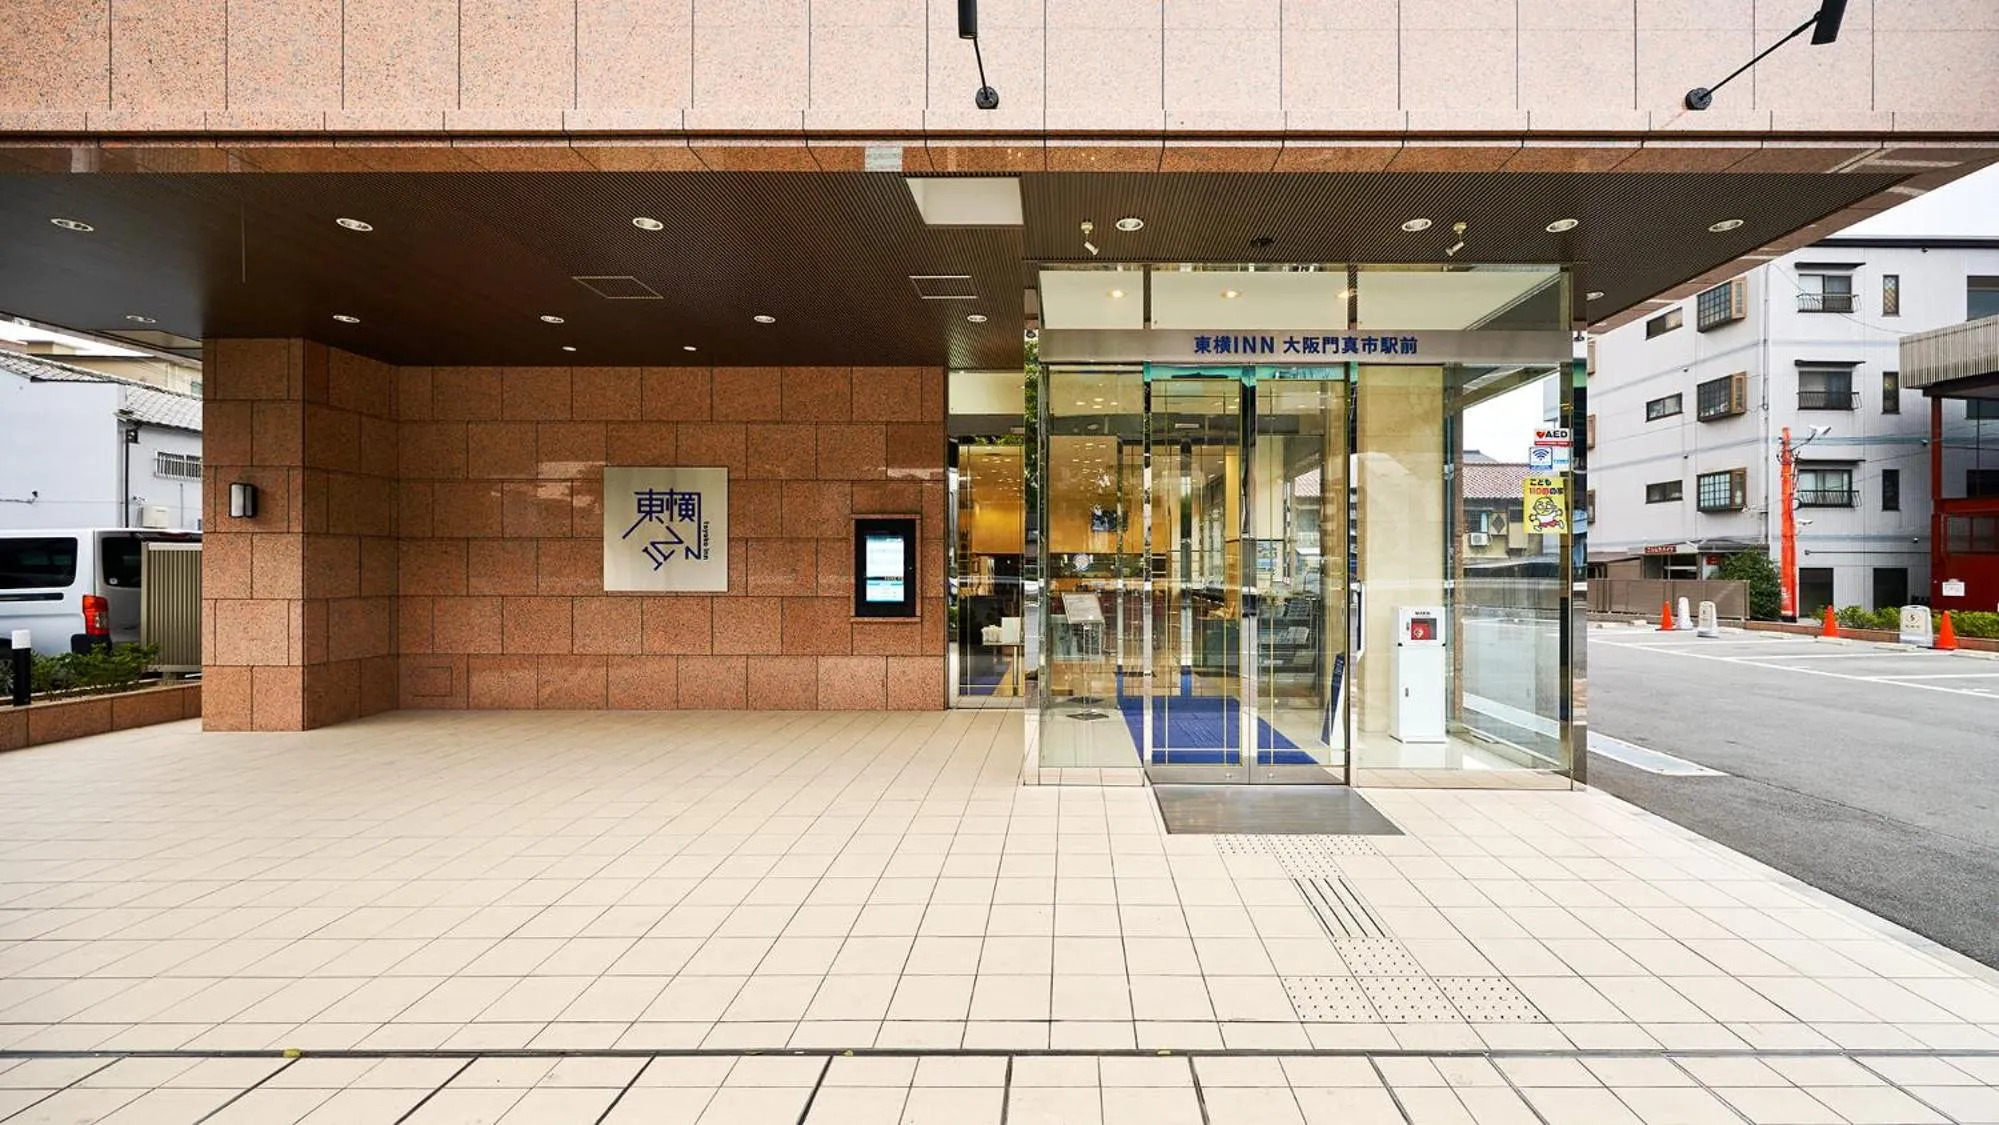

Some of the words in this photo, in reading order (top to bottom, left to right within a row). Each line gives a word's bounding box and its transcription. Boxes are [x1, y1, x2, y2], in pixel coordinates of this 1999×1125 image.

[1194, 336, 1275, 354] 東横INN
[1283, 336, 1418, 354] 大阪門真市駅前
[1545, 430, 1568, 438] AED
[1529, 478, 1552, 486] こども
